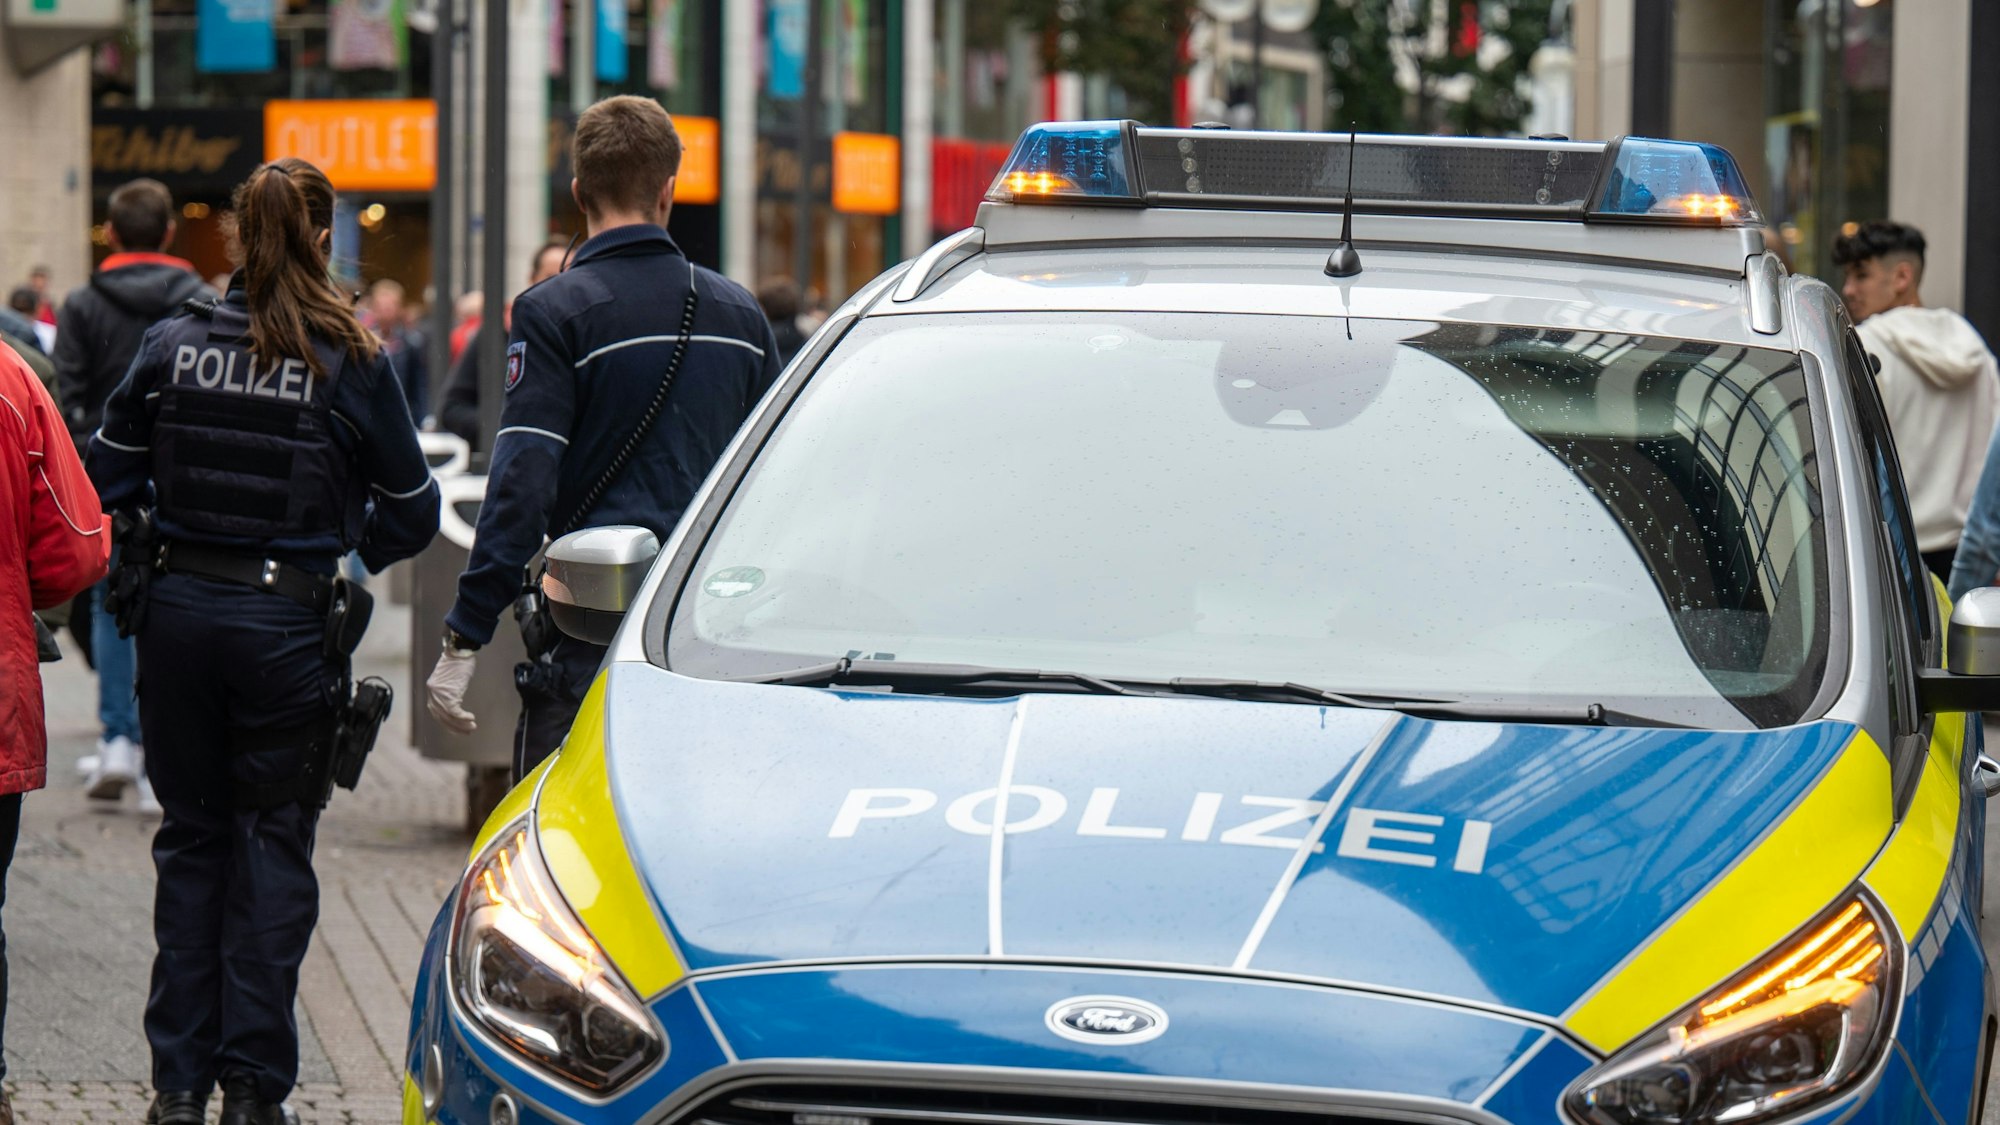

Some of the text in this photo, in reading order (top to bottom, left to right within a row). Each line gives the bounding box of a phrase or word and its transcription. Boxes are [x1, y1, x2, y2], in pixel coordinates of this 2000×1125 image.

[276, 115, 437, 172] OUTLET
[172, 344, 316, 403] POLIZEI
[827, 784, 1492, 875] POLIZEI
[1076, 1007, 1138, 1033] Ford
